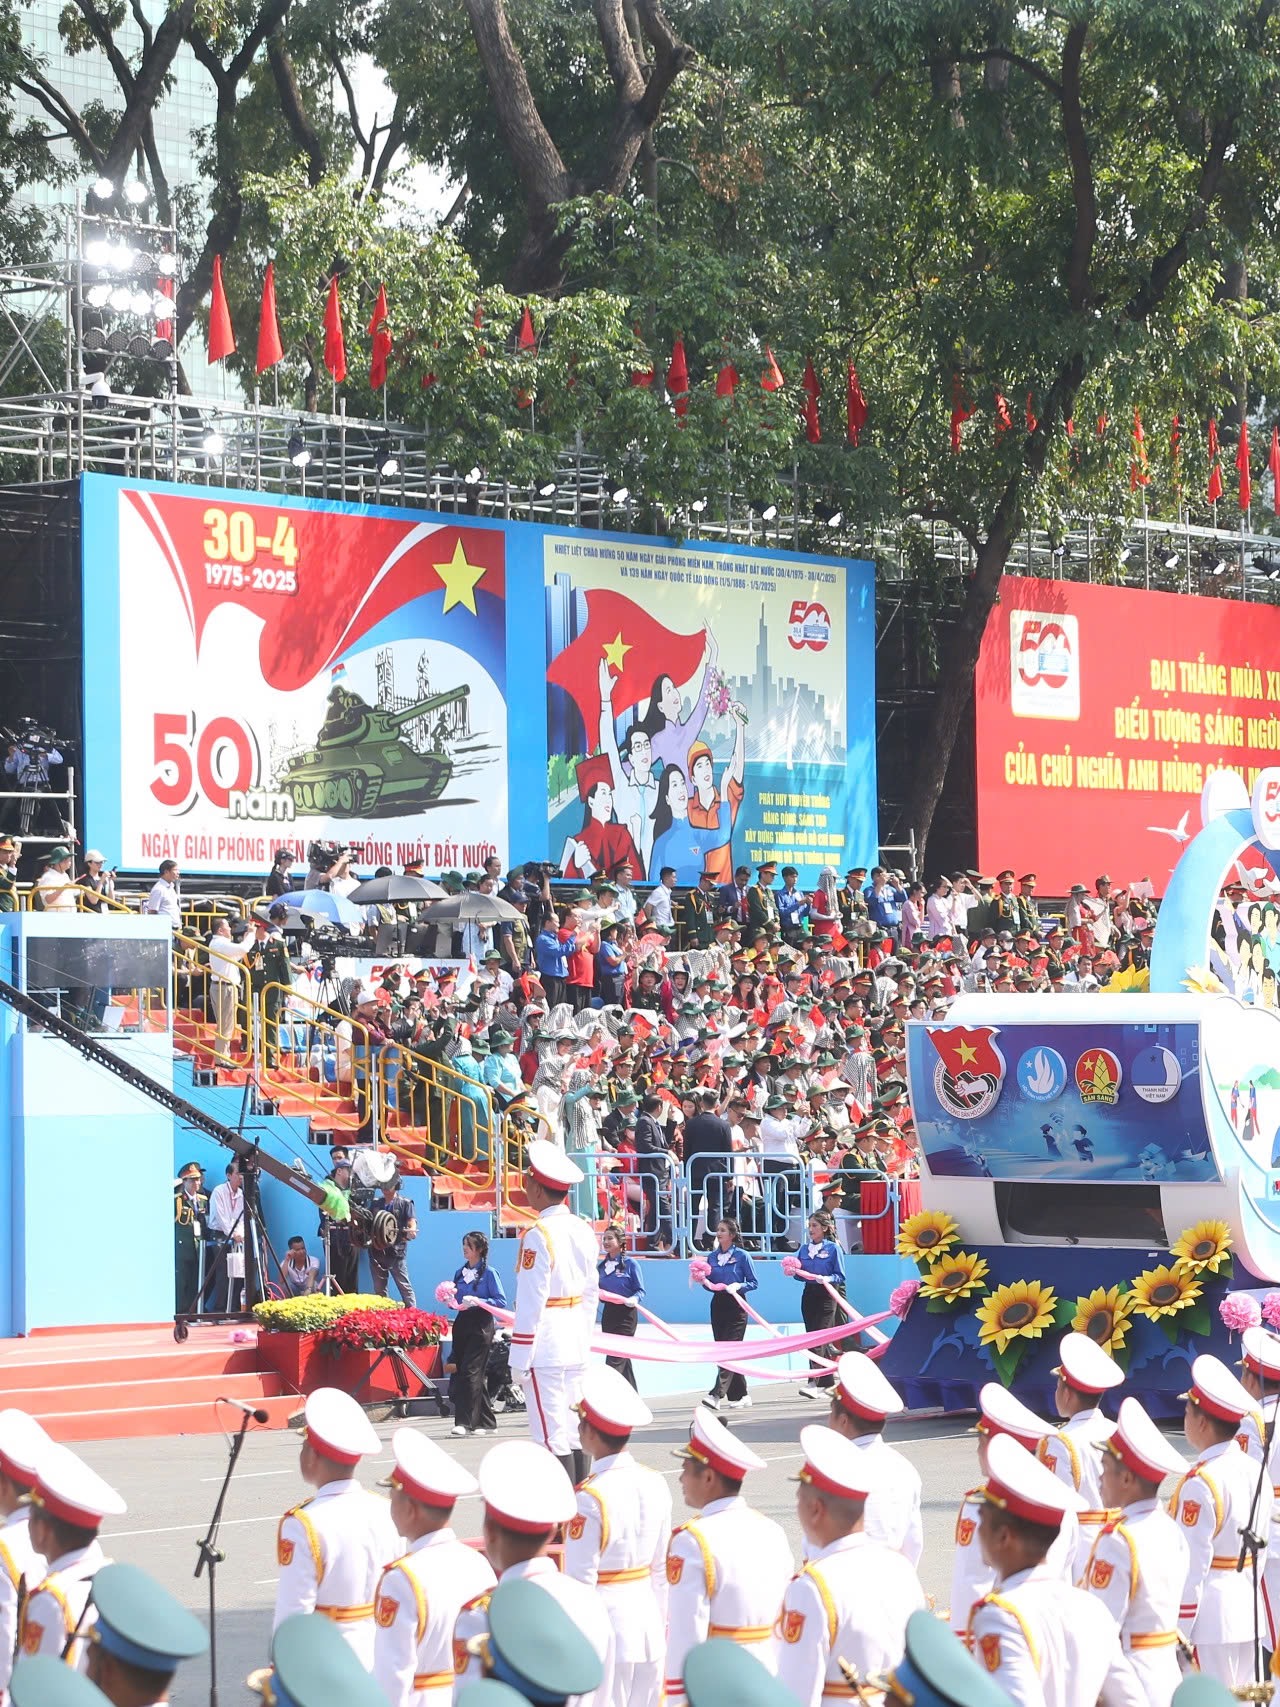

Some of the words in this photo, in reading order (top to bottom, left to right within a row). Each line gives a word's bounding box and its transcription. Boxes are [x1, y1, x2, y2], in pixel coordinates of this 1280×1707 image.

[203, 508, 298, 566] 30-4
[204, 562, 297, 592] 1975-2025
[1150, 659, 1176, 698] ĐẠI
[1178, 652, 1227, 696] THẮNG
[1230, 662, 1263, 699] MÙA
[1114, 696, 1149, 741] BIỂU
[1152, 707, 1201, 749] TƯỢNG
[1204, 708, 1244, 747] SÁNG
[1248, 712, 1280, 751] NGỜI
[149, 712, 253, 809] 50
[1004, 741, 1038, 785] CỦA
[1041, 744, 1072, 788] CHỦ
[1077, 752, 1124, 790] NGHĨA
[1127, 758, 1159, 791] ANH
[1162, 754, 1202, 794] HÙNG
[228, 785, 295, 821] năm
[141, 829, 180, 858] NGÀY
[217, 832, 265, 862] PHÓNG
[396, 834, 431, 868] NHẤT
[434, 835, 458, 868] ĐẤT
